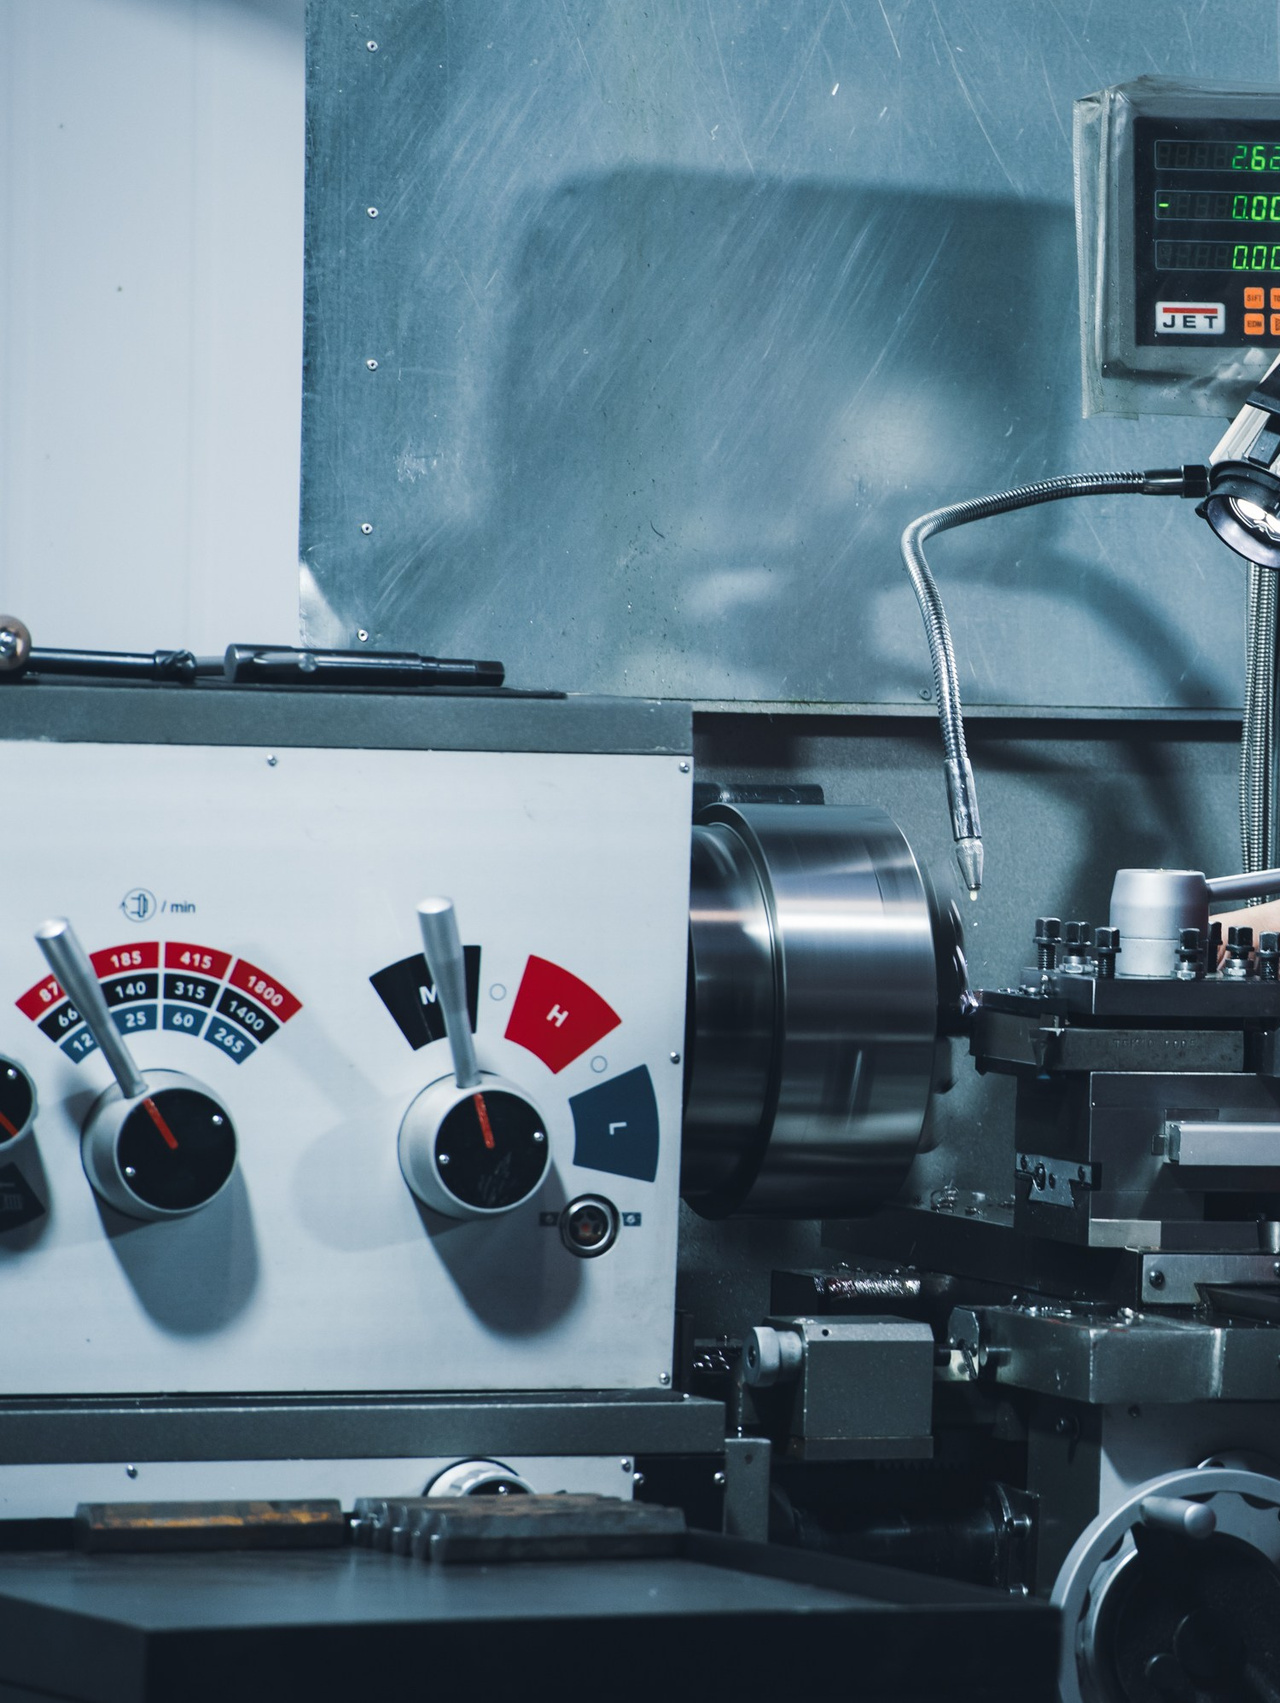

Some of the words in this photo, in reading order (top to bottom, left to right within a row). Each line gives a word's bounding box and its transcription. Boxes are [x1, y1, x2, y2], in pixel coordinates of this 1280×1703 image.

[1162, 314, 1219, 330] JET
[170, 900, 197, 914] min
[109, 950, 143, 969] 185
[179, 951, 213, 970] 415
[39, 981, 59, 1003] 87
[115, 980, 147, 999] 140
[174, 981, 206, 1000] 315
[247, 975, 285, 1008] 1800
[418, 983, 437, 1006] M
[58, 1007, 79, 1028] 66
[125, 1011, 147, 1028] 25
[172, 1012, 195, 1028] 60
[228, 1000, 266, 1032] 1400
[545, 1003, 570, 1028] H
[72, 1033, 94, 1052] 12
[213, 1027, 246, 1054] 265
[608, 1121, 627, 1136] L
